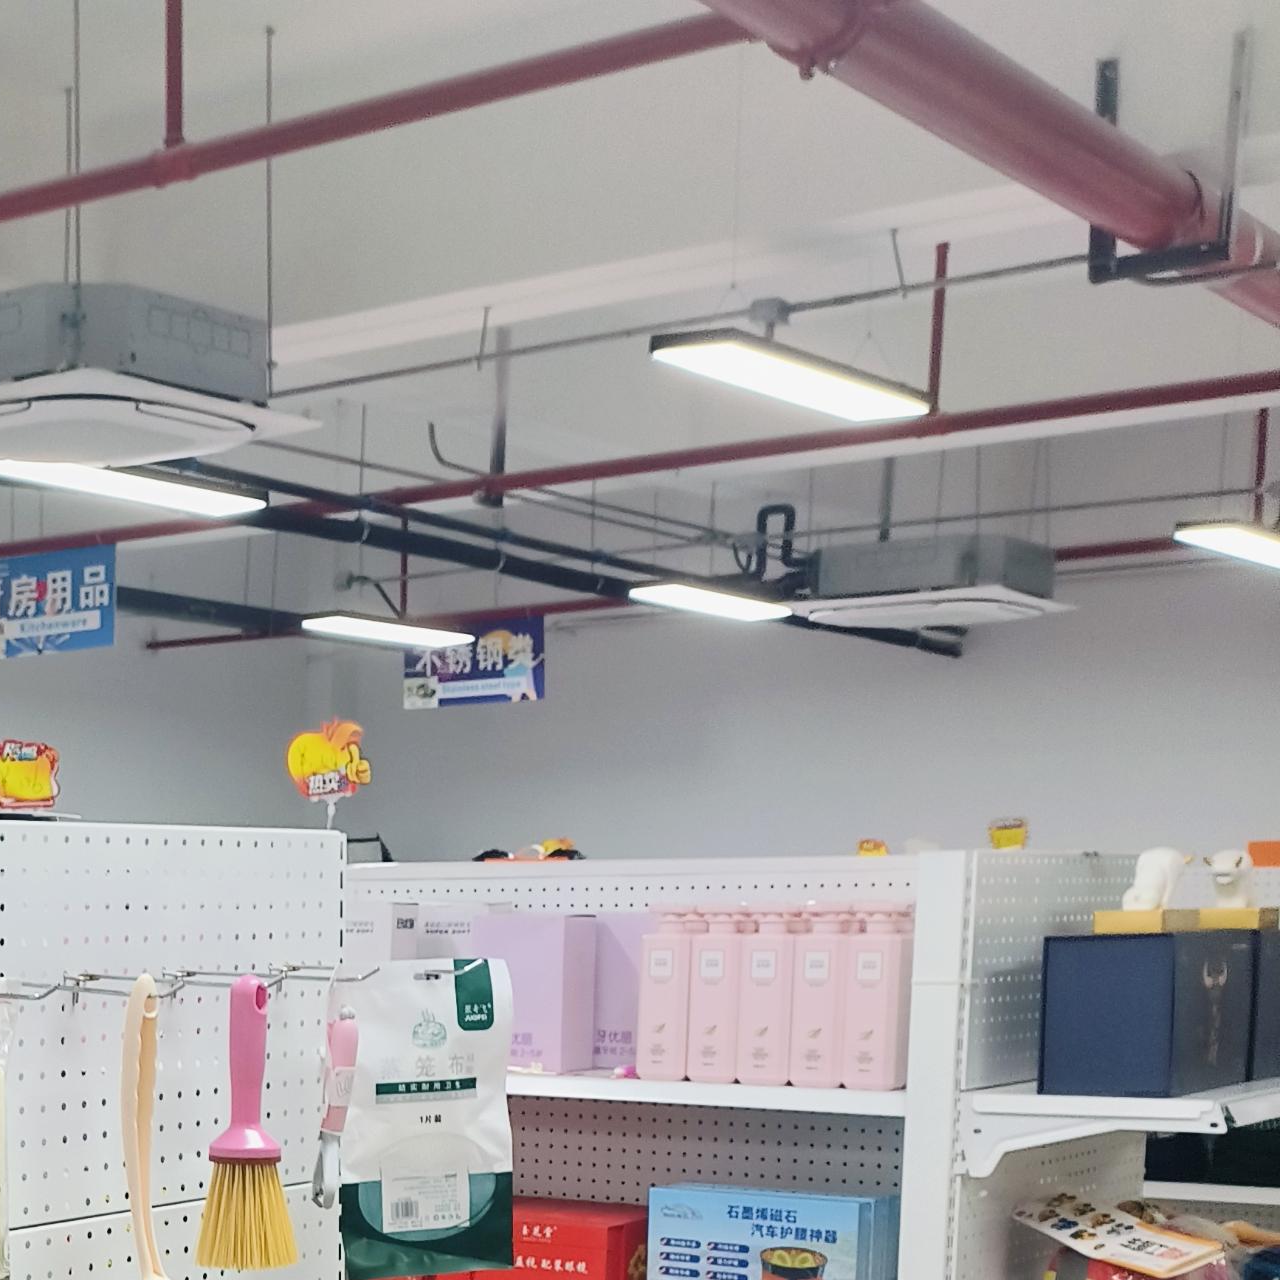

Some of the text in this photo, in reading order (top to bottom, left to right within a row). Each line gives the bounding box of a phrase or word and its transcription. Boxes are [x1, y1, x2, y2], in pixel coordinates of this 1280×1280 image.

[727, 1204, 798, 1224] 石墨烯磁石
[751, 1223, 838, 1244] 汽车护腰神器
